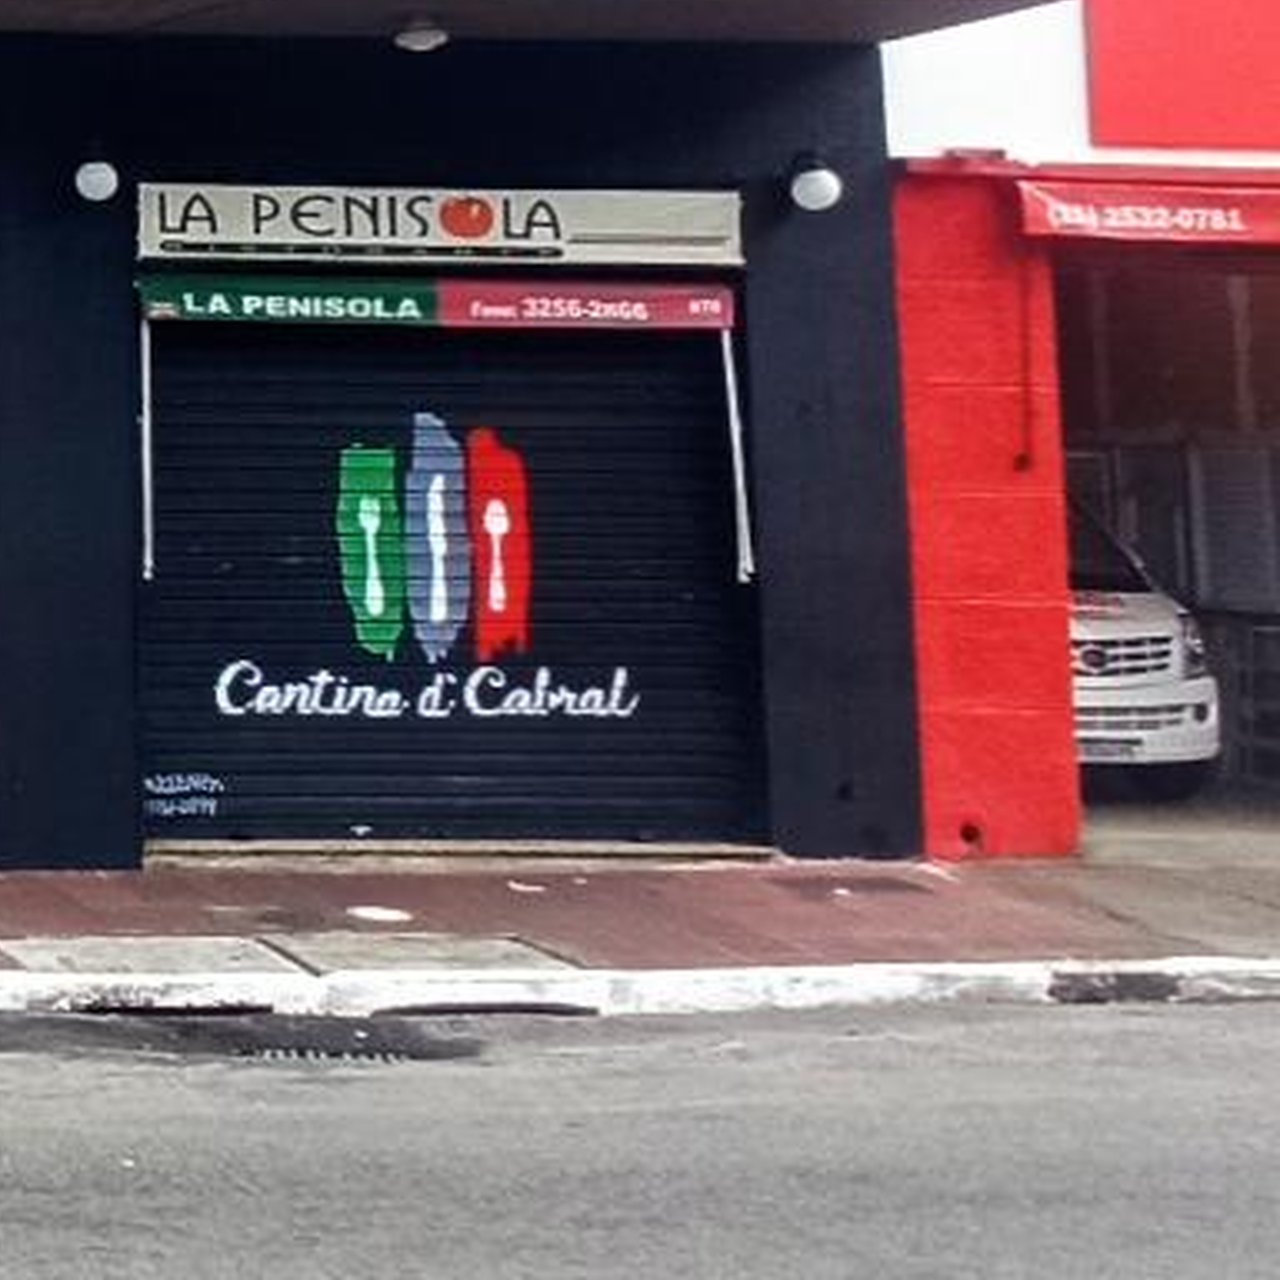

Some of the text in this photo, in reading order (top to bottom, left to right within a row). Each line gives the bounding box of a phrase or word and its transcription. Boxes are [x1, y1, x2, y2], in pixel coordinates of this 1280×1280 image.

[159, 192, 218, 235] LA
[183, 292, 232, 315] LA
[241, 294, 424, 319] PENISOLA
[214, 660, 409, 718] Cantina
[462, 665, 640, 717] Cabral
